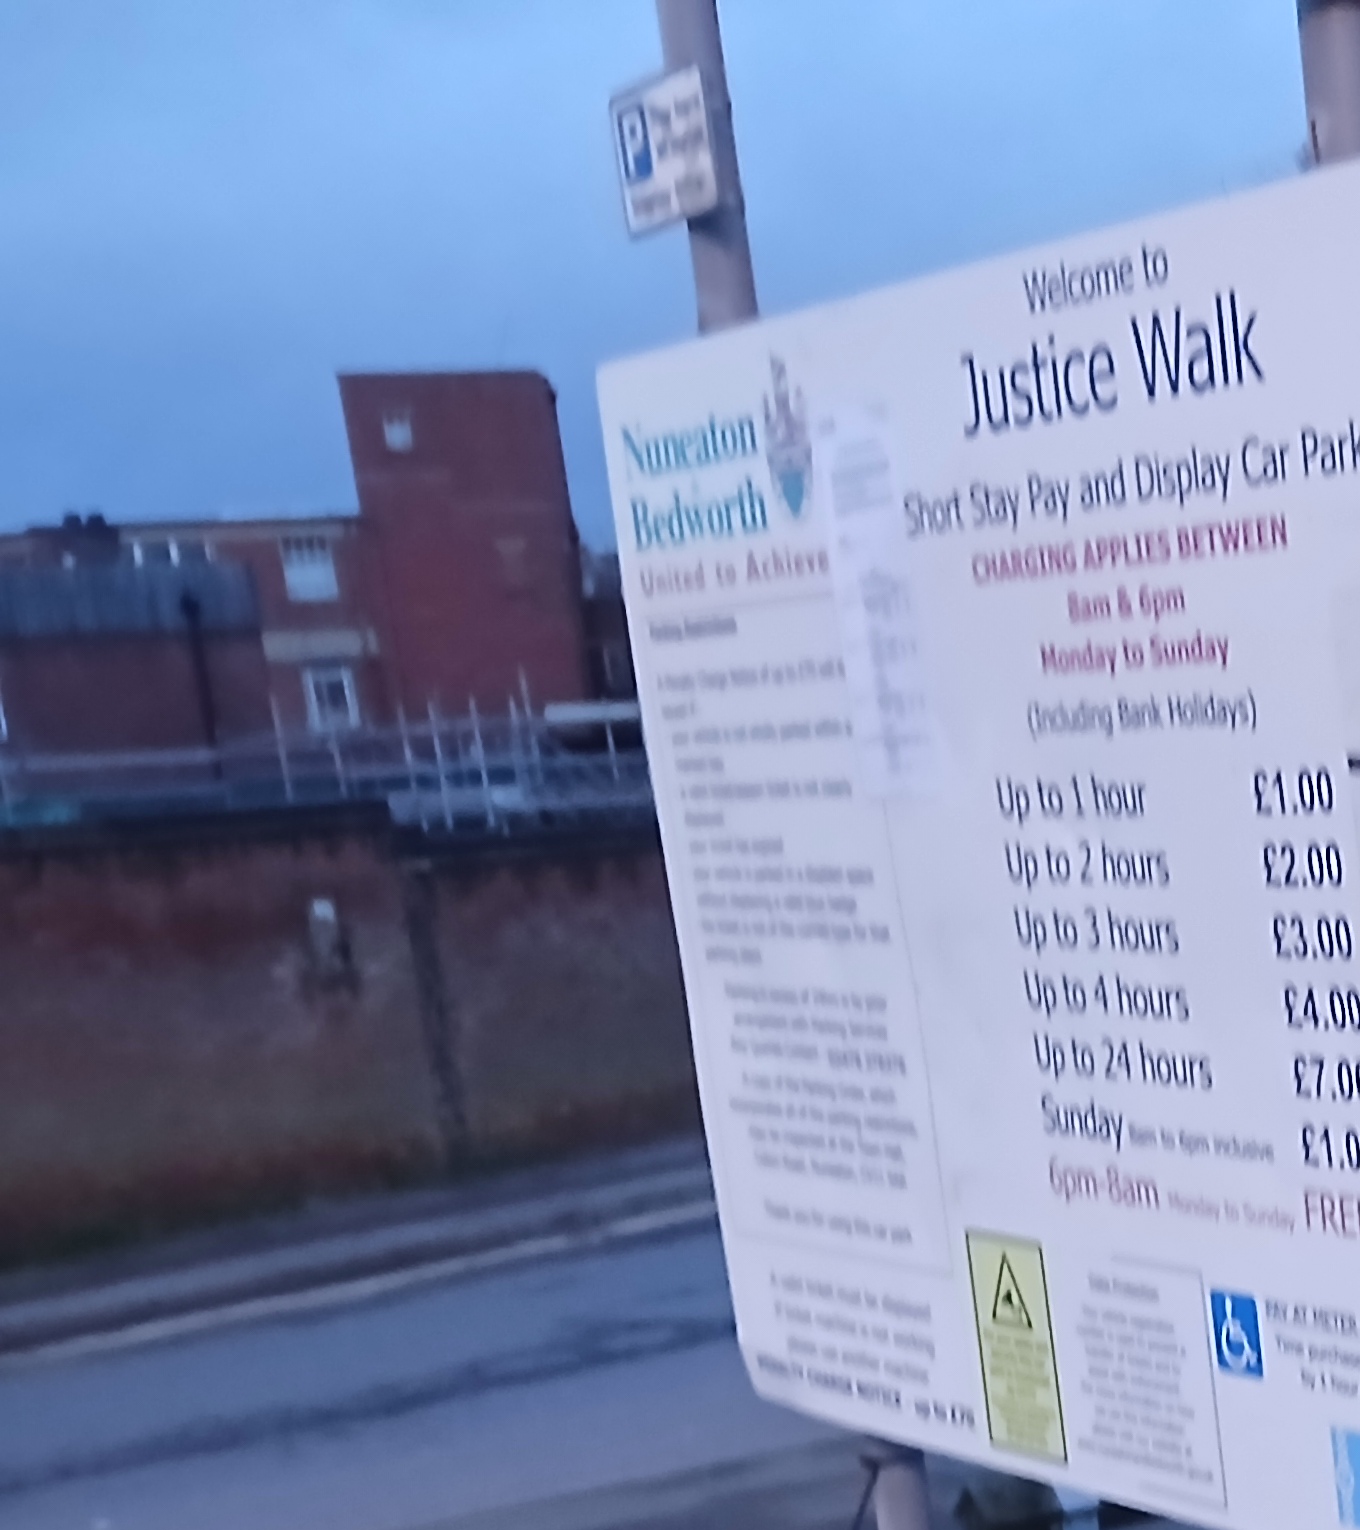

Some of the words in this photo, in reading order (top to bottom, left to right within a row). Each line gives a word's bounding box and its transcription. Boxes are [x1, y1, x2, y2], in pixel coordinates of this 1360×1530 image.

[1022, 256, 1133, 315] Welcome
[1141, 243, 1168, 288] to
[961, 333, 1118, 438] Justice
[1131, 288, 1264, 403] Walk
[621, 411, 758, 475] Nuneaton
[630, 475, 767, 552] Bedworth
[904, 488, 964, 538] Short
[969, 481, 1019, 530] Stay
[1027, 472, 1069, 526] Pay
[1080, 458, 1126, 506] and
[1134, 446, 1230, 506] Display
[1242, 433, 1290, 486] Car
[640, 559, 705, 598] United
[716, 560, 736, 588] to
[746, 546, 829, 582] Achieve
[972, 540, 1077, 587] CHARGING
[1083, 527, 1170, 570] APPLIES
[1177, 512, 1287, 562] BETWEEN
[1067, 590, 1111, 624] 8am
[1117, 584, 1133, 621] &
[1139, 584, 1185, 624] 6pm
[1040, 637, 1116, 679] Monday
[1122, 636, 1144, 670] to
[1149, 628, 1229, 670] Sunday
[1027, 698, 1113, 742] (Including
[1118, 692, 1164, 731] Bank
[1168, 687, 1257, 734] Holidays)
[996, 774, 1030, 827] Up
[1037, 773, 1063, 816] to
[1071, 772, 1084, 817] 1
[1091, 772, 1146, 818] hour
[1254, 765, 1333, 816] £1.00
[1005, 840, 1038, 894] Up
[1045, 841, 1071, 885] to
[1079, 839, 1093, 885] 2
[1101, 840, 1170, 888] hours
[1264, 836, 1343, 888] £2.00
[1014, 904, 1047, 957] Up
[1053, 906, 1078, 950] to
[1084, 904, 1100, 950] 3
[1107, 904, 1179, 956] hours
[1273, 909, 1352, 961] £3.00
[1023, 969, 1057, 1021] Up
[1062, 972, 1086, 1014] to
[1095, 972, 1108, 1016] 4
[1115, 972, 1190, 1023] hours
[1034, 1032, 1065, 1083] Up
[1071, 1036, 1095, 1078] to
[1103, 1035, 1131, 1081] 24
[1139, 1039, 1213, 1091] hours
[1041, 1093, 1123, 1153] Sunday
[1049, 1154, 1160, 1211] 6pm-8am
[1265, 1299, 1287, 1322] PAY
[1313, 1306, 1358, 1337] METER
